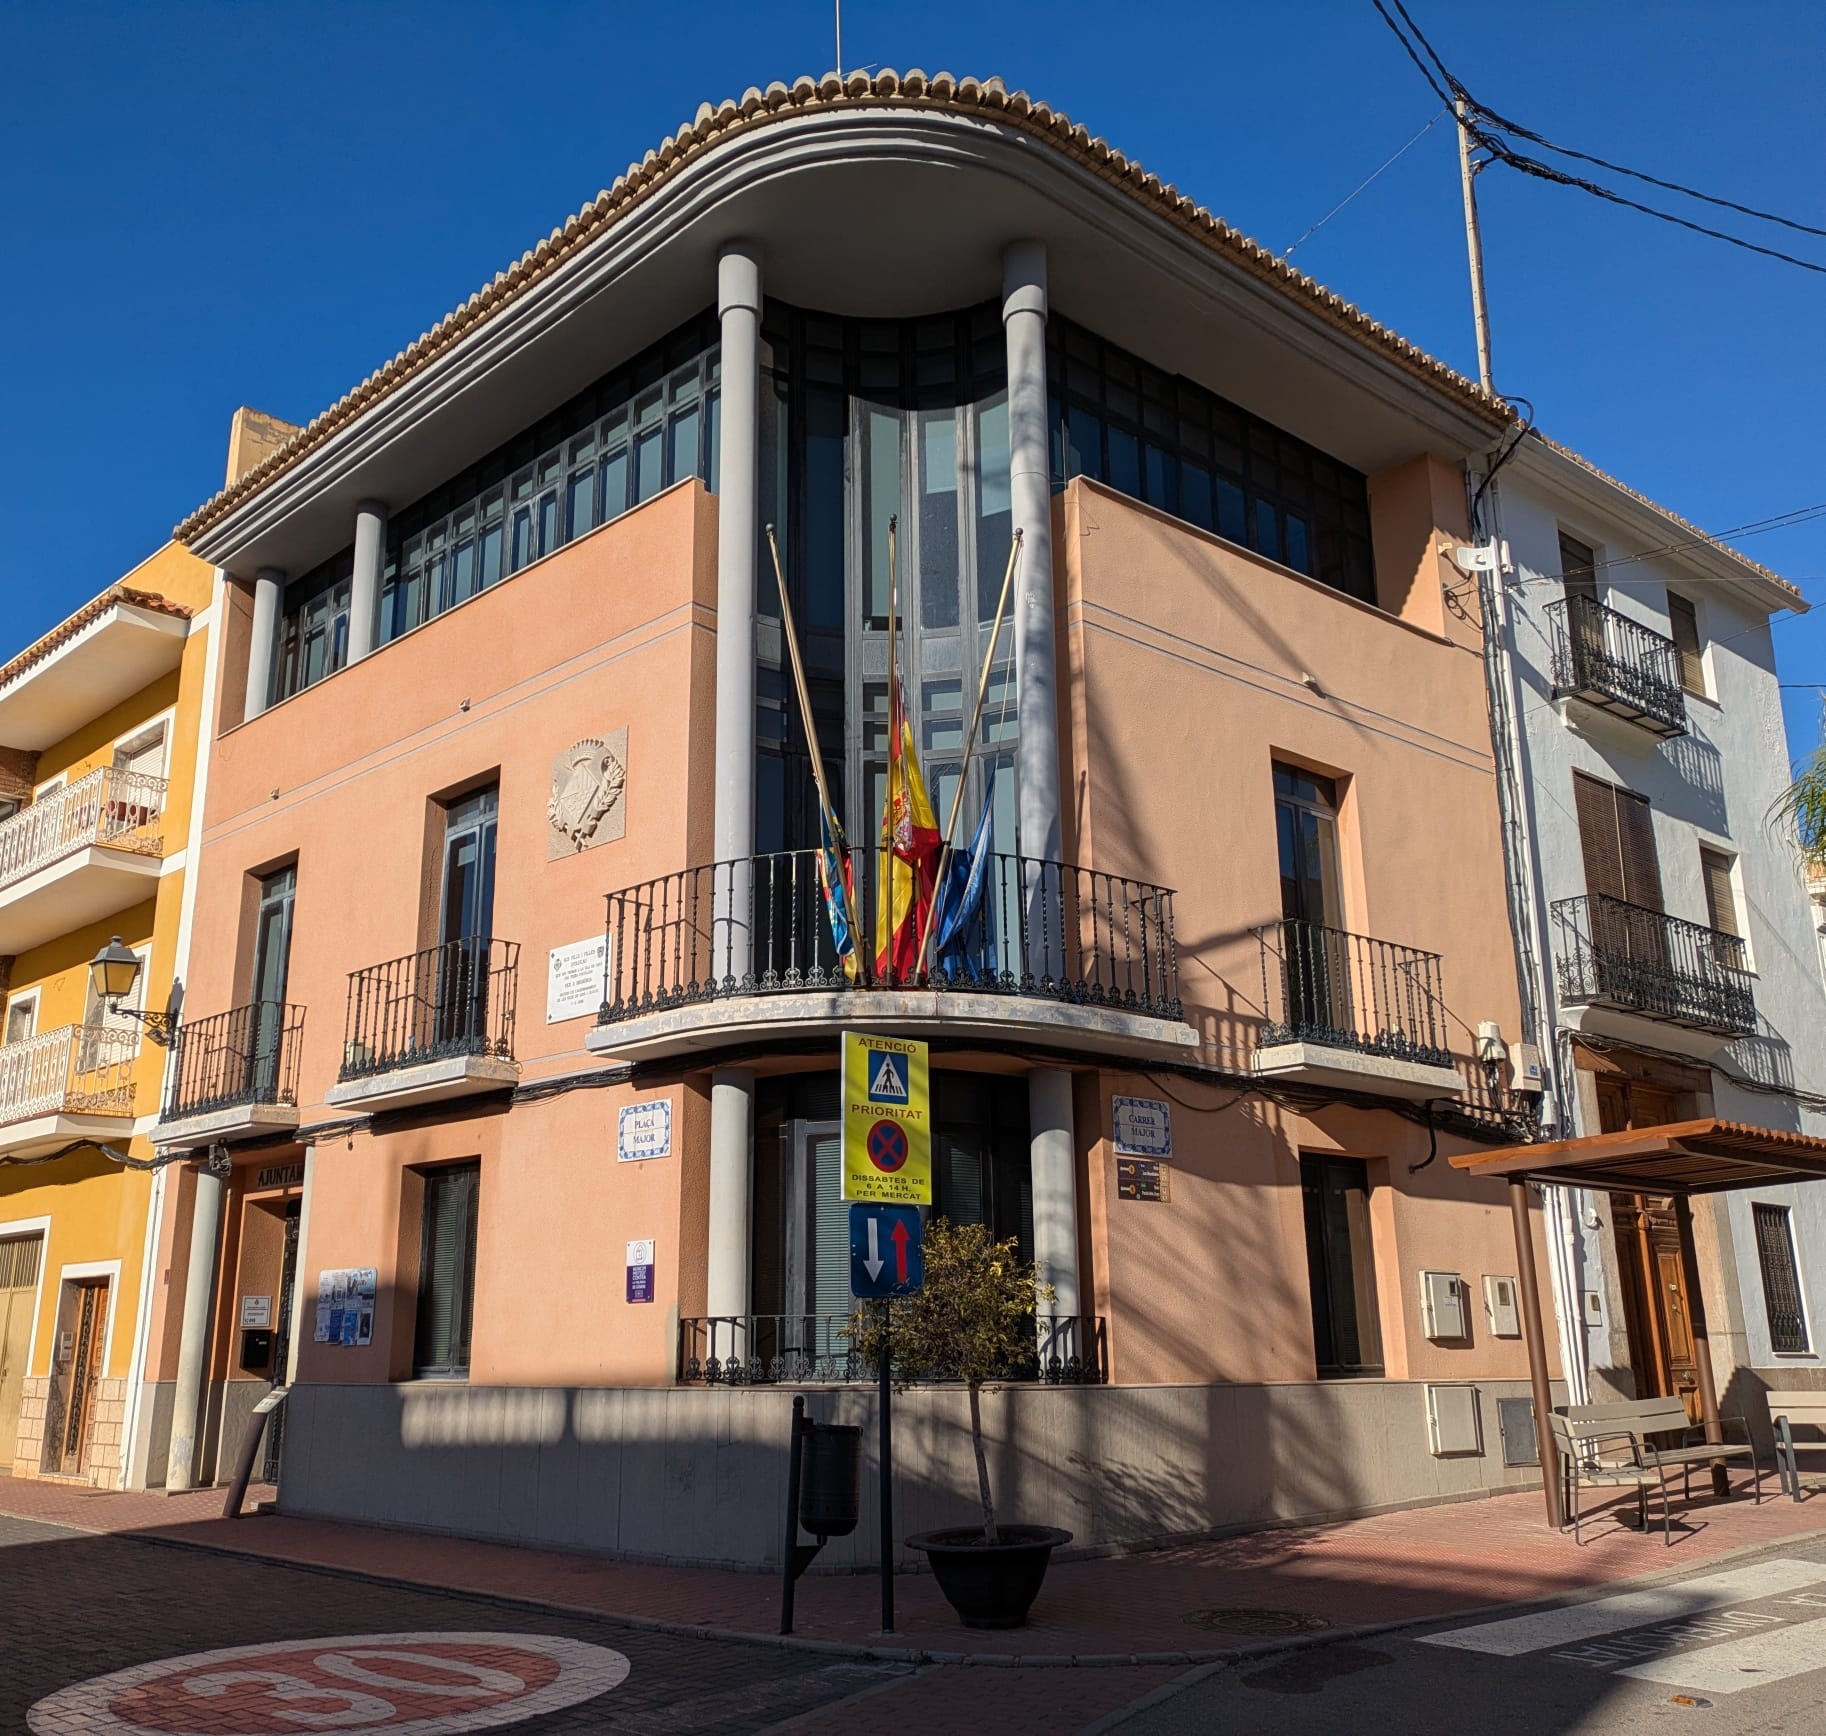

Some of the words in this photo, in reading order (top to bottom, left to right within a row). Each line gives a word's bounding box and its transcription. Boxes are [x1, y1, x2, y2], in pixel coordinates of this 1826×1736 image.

[858, 1037, 917, 1053] ATENCIÓ
[851, 1104, 922, 1120] PRIORITAT
[634, 1119, 655, 1129] PLAÇA
[1131, 1127, 1155, 1138] MAJOR
[633, 1134, 655, 1144] MAJOR
[852, 1174, 906, 1184] DISSABTES
[881, 1191, 921, 1200] MERCAT
[182, 1650, 526, 1725] 30
